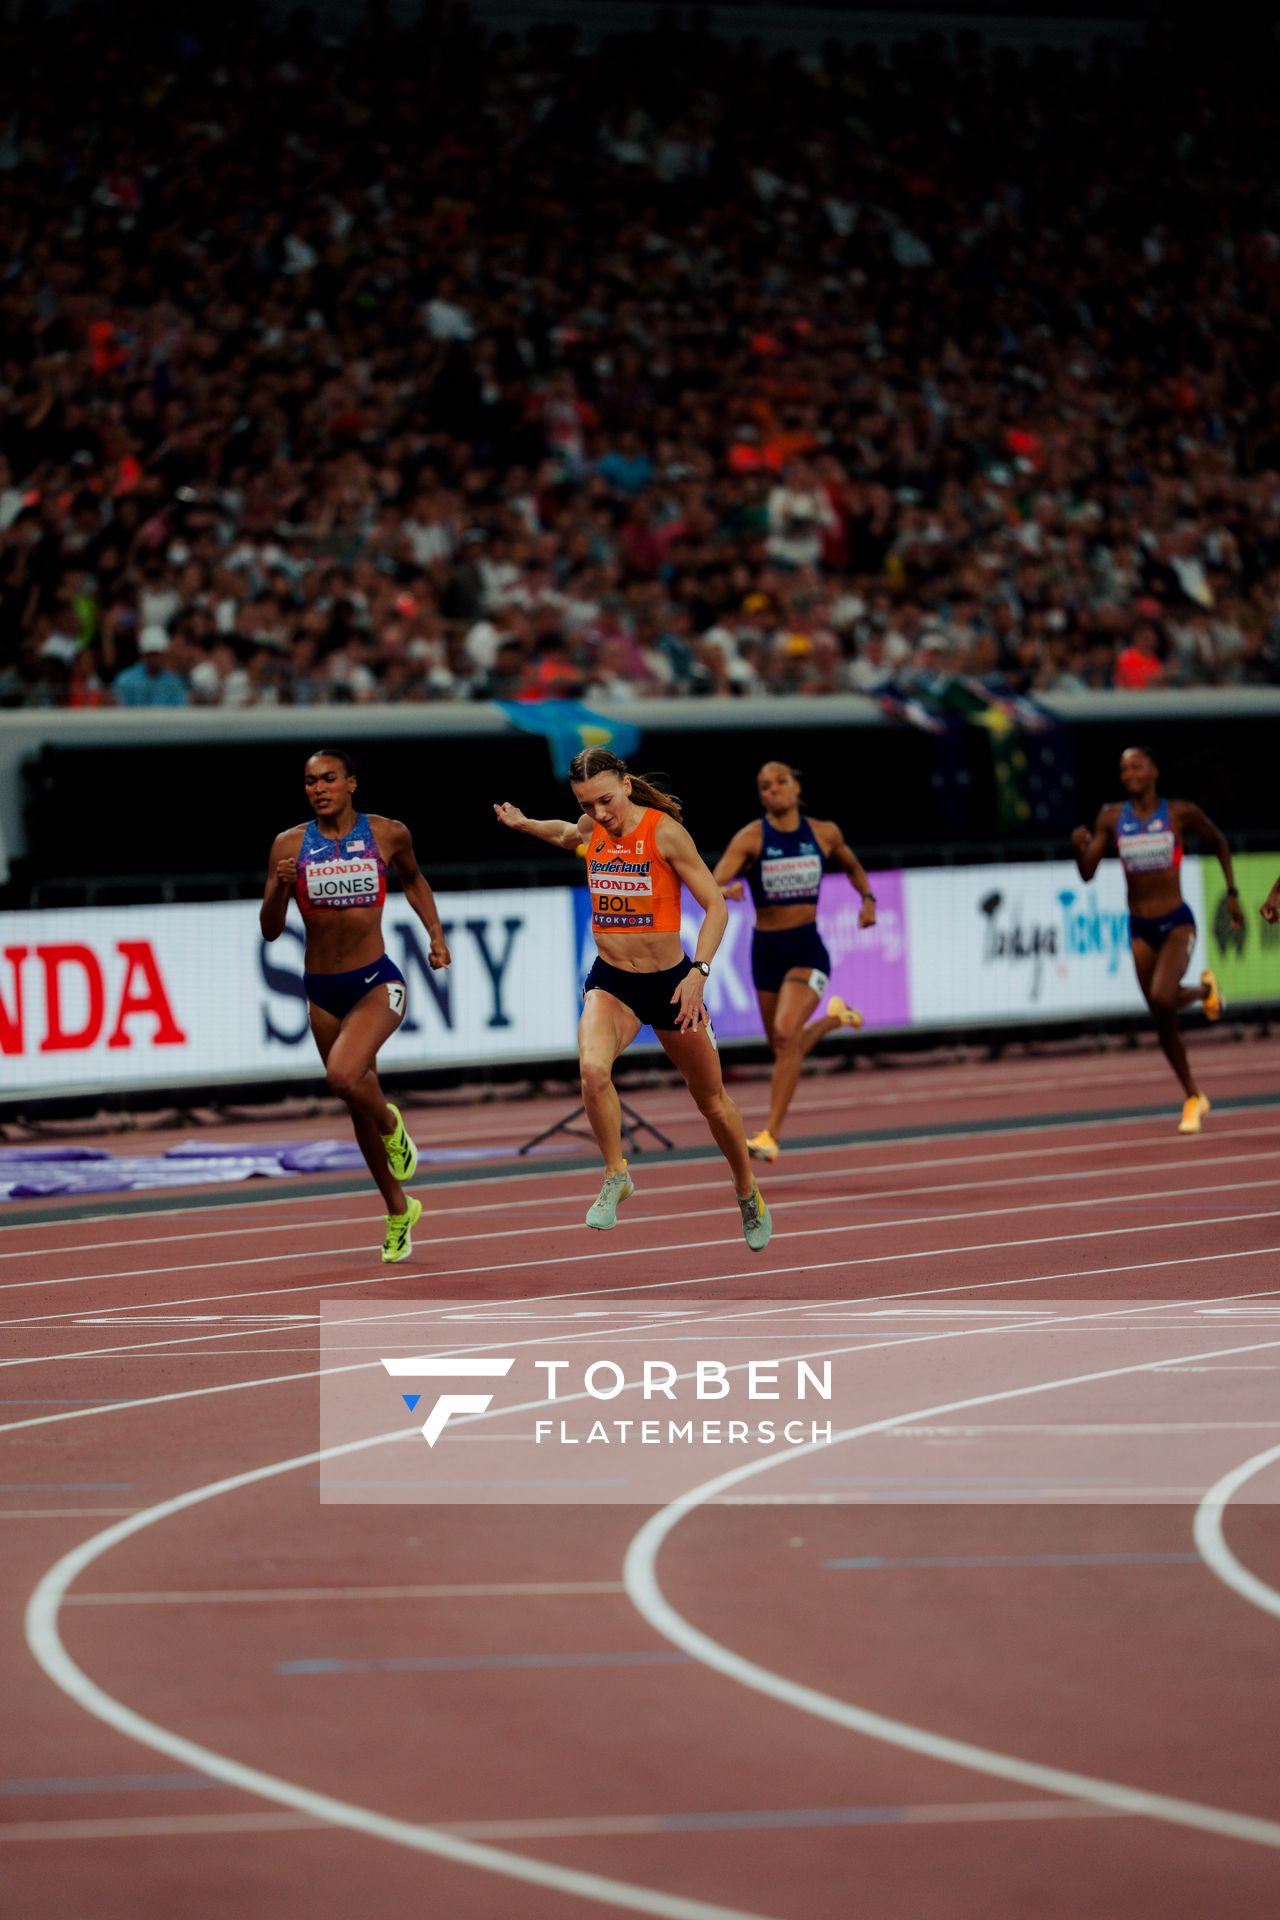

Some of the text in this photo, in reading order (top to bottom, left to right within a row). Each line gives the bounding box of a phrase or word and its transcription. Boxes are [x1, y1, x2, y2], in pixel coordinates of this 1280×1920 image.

[308, 863, 375, 877] HONDA
[590, 859, 650, 877] Nederland
[313, 877, 375, 896] JONES
[590, 879, 650, 892] HONDA
[599, 896, 636, 912] BOL
[259, 918, 524, 1046] SNY
[395, 989, 403, 1008] 7
